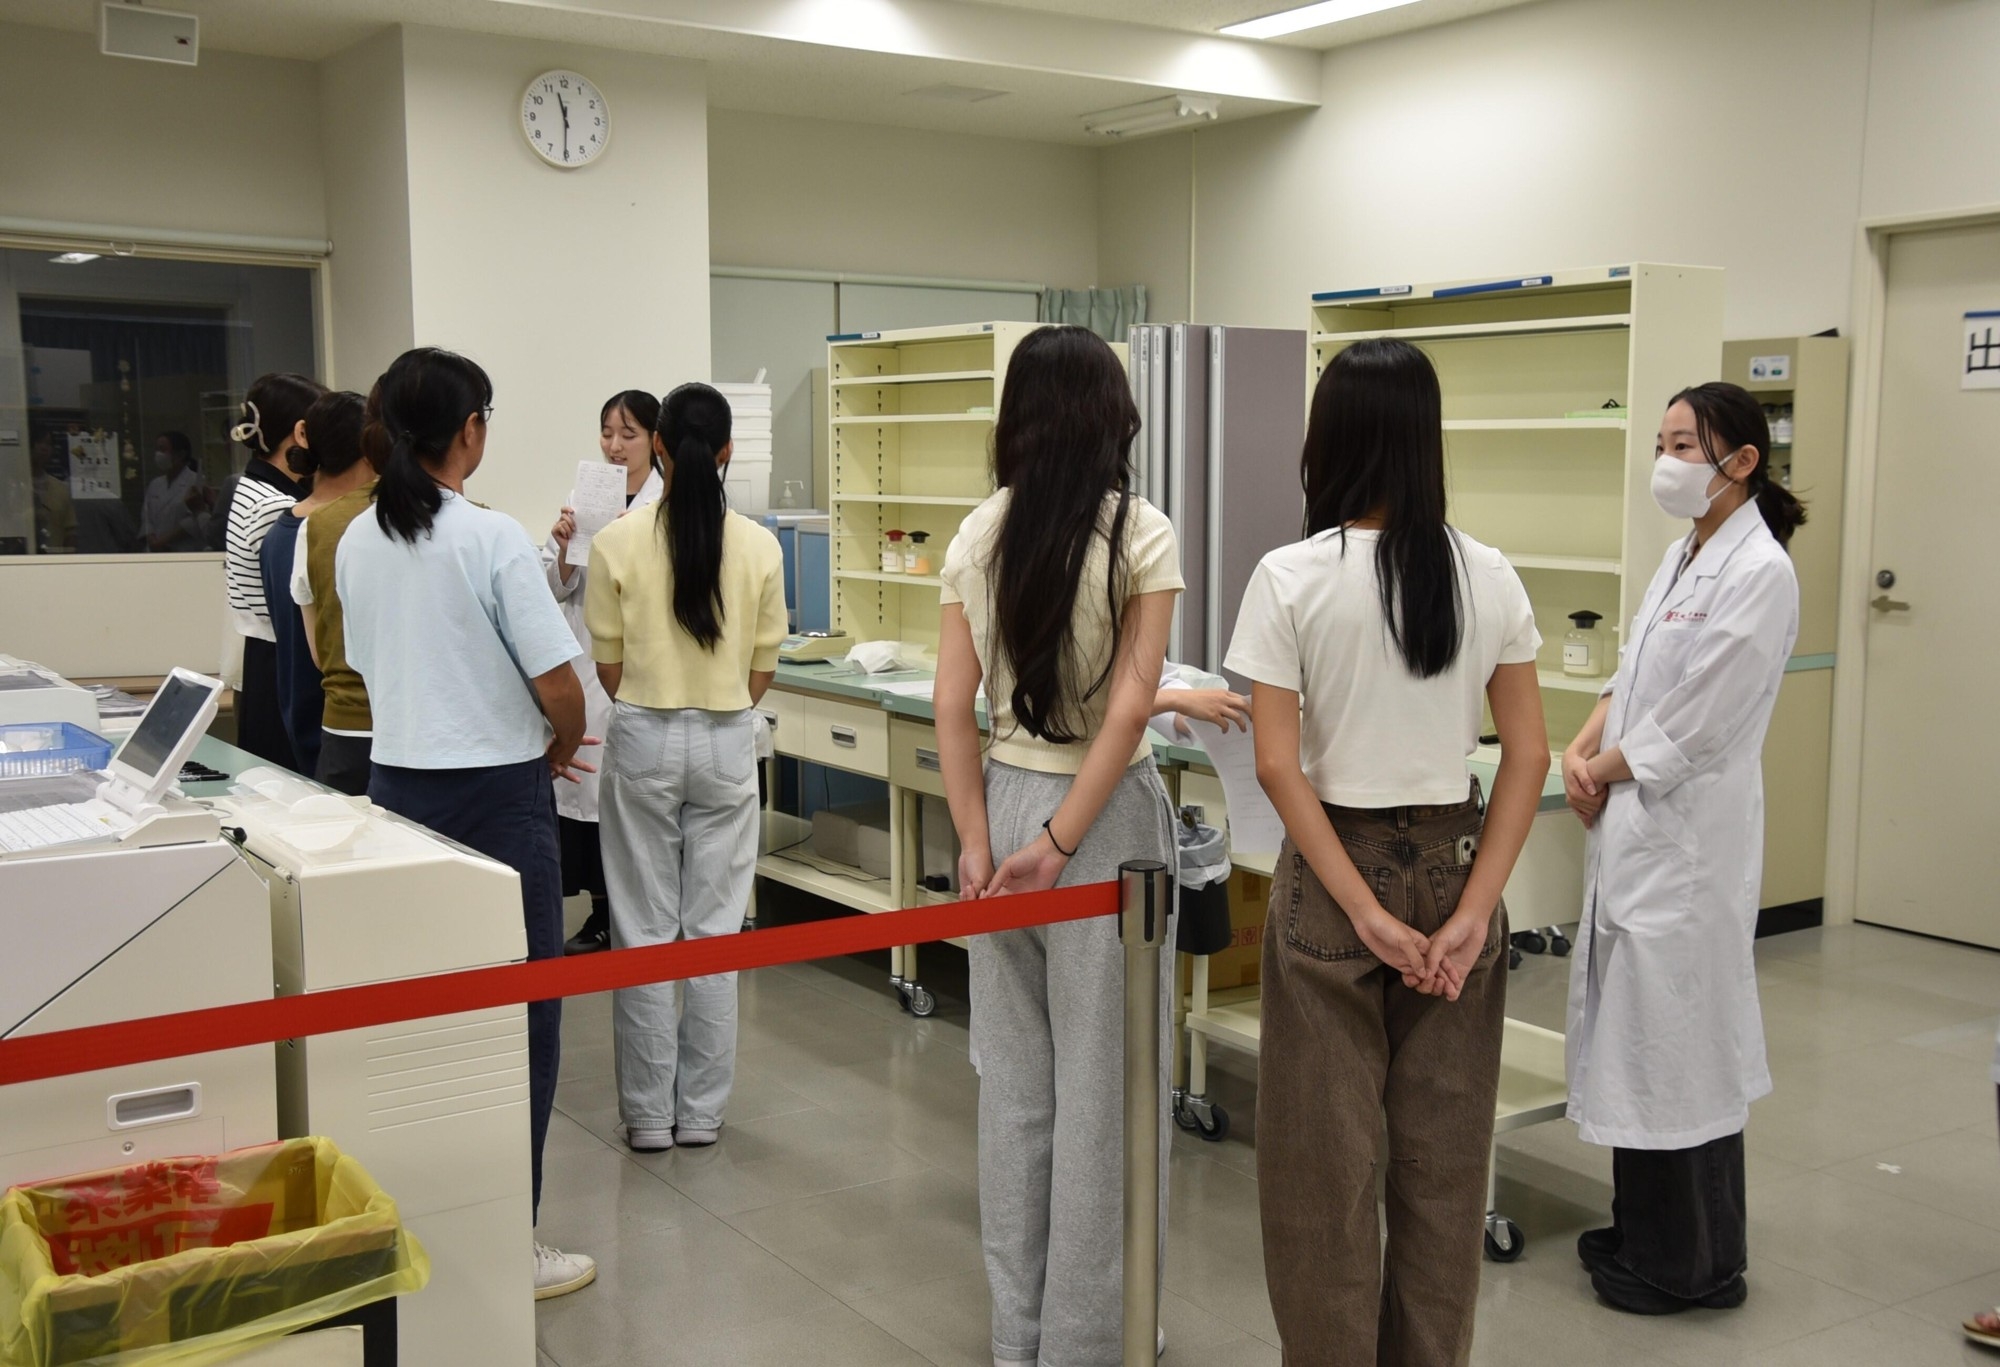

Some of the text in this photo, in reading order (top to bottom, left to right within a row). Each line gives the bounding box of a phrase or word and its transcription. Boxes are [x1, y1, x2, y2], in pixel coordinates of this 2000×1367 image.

[543, 84, 553, 93] 11
[559, 79, 569, 89] 12
[577, 86, 582, 95] 1
[533, 95, 543, 105] 10
[589, 99, 595, 109] 2
[529, 112, 536, 121] 9
[594, 117, 600, 126] 3
[535, 129, 541, 139] 8
[590, 134, 596, 143] 4
[547, 143, 553, 152] 7
[579, 145, 585, 154] 5
[1966, 327, 2000, 374] 出
